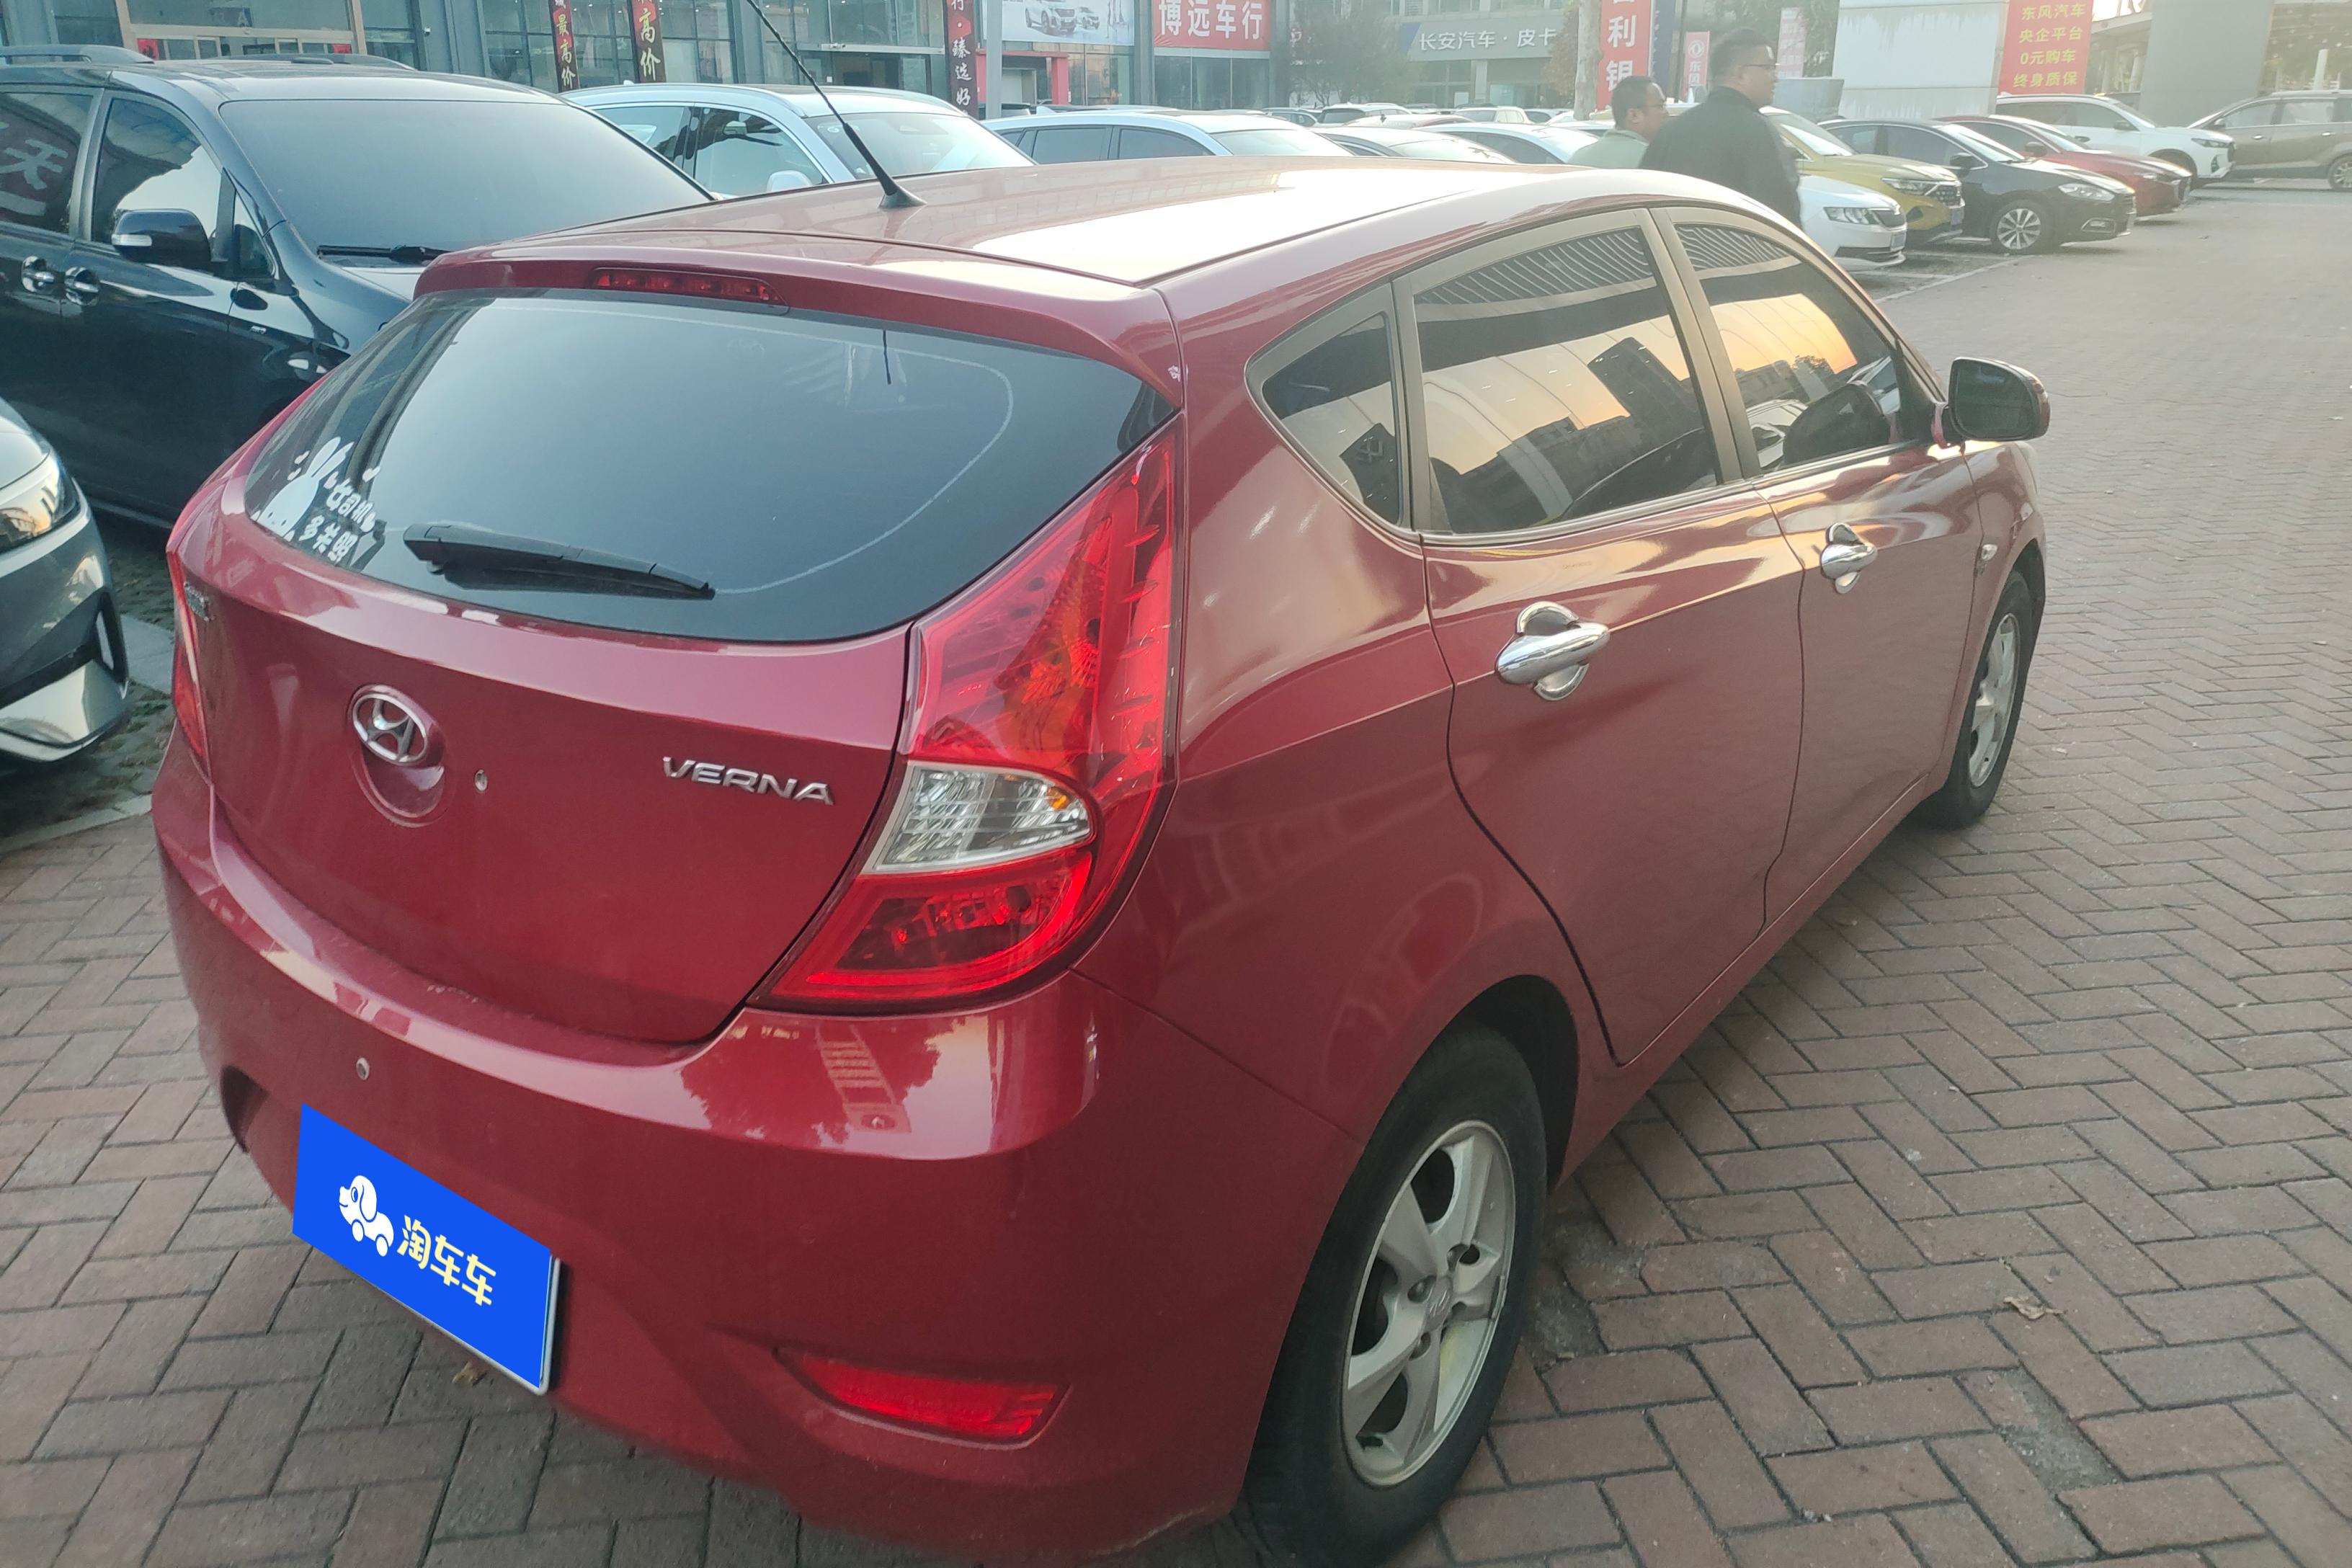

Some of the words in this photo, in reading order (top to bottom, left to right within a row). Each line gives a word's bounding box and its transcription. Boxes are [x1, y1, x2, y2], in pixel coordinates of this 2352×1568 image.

[1159, 0, 1262, 40] 博远车行
[2021, 4, 2086, 20] 东风汽车
[638, 0, 661, 81] 高价
[1606, 0, 1636, 109] 利银
[2018, 26, 2082, 43] 央企平台
[951, 0, 972, 115] 行·臻选好
[2020, 48, 2075, 65] 0元购车
[2013, 71, 2077, 87] 终身质保
[326, 478, 374, 523] 女司机
[662, 757, 834, 806] VERNA
